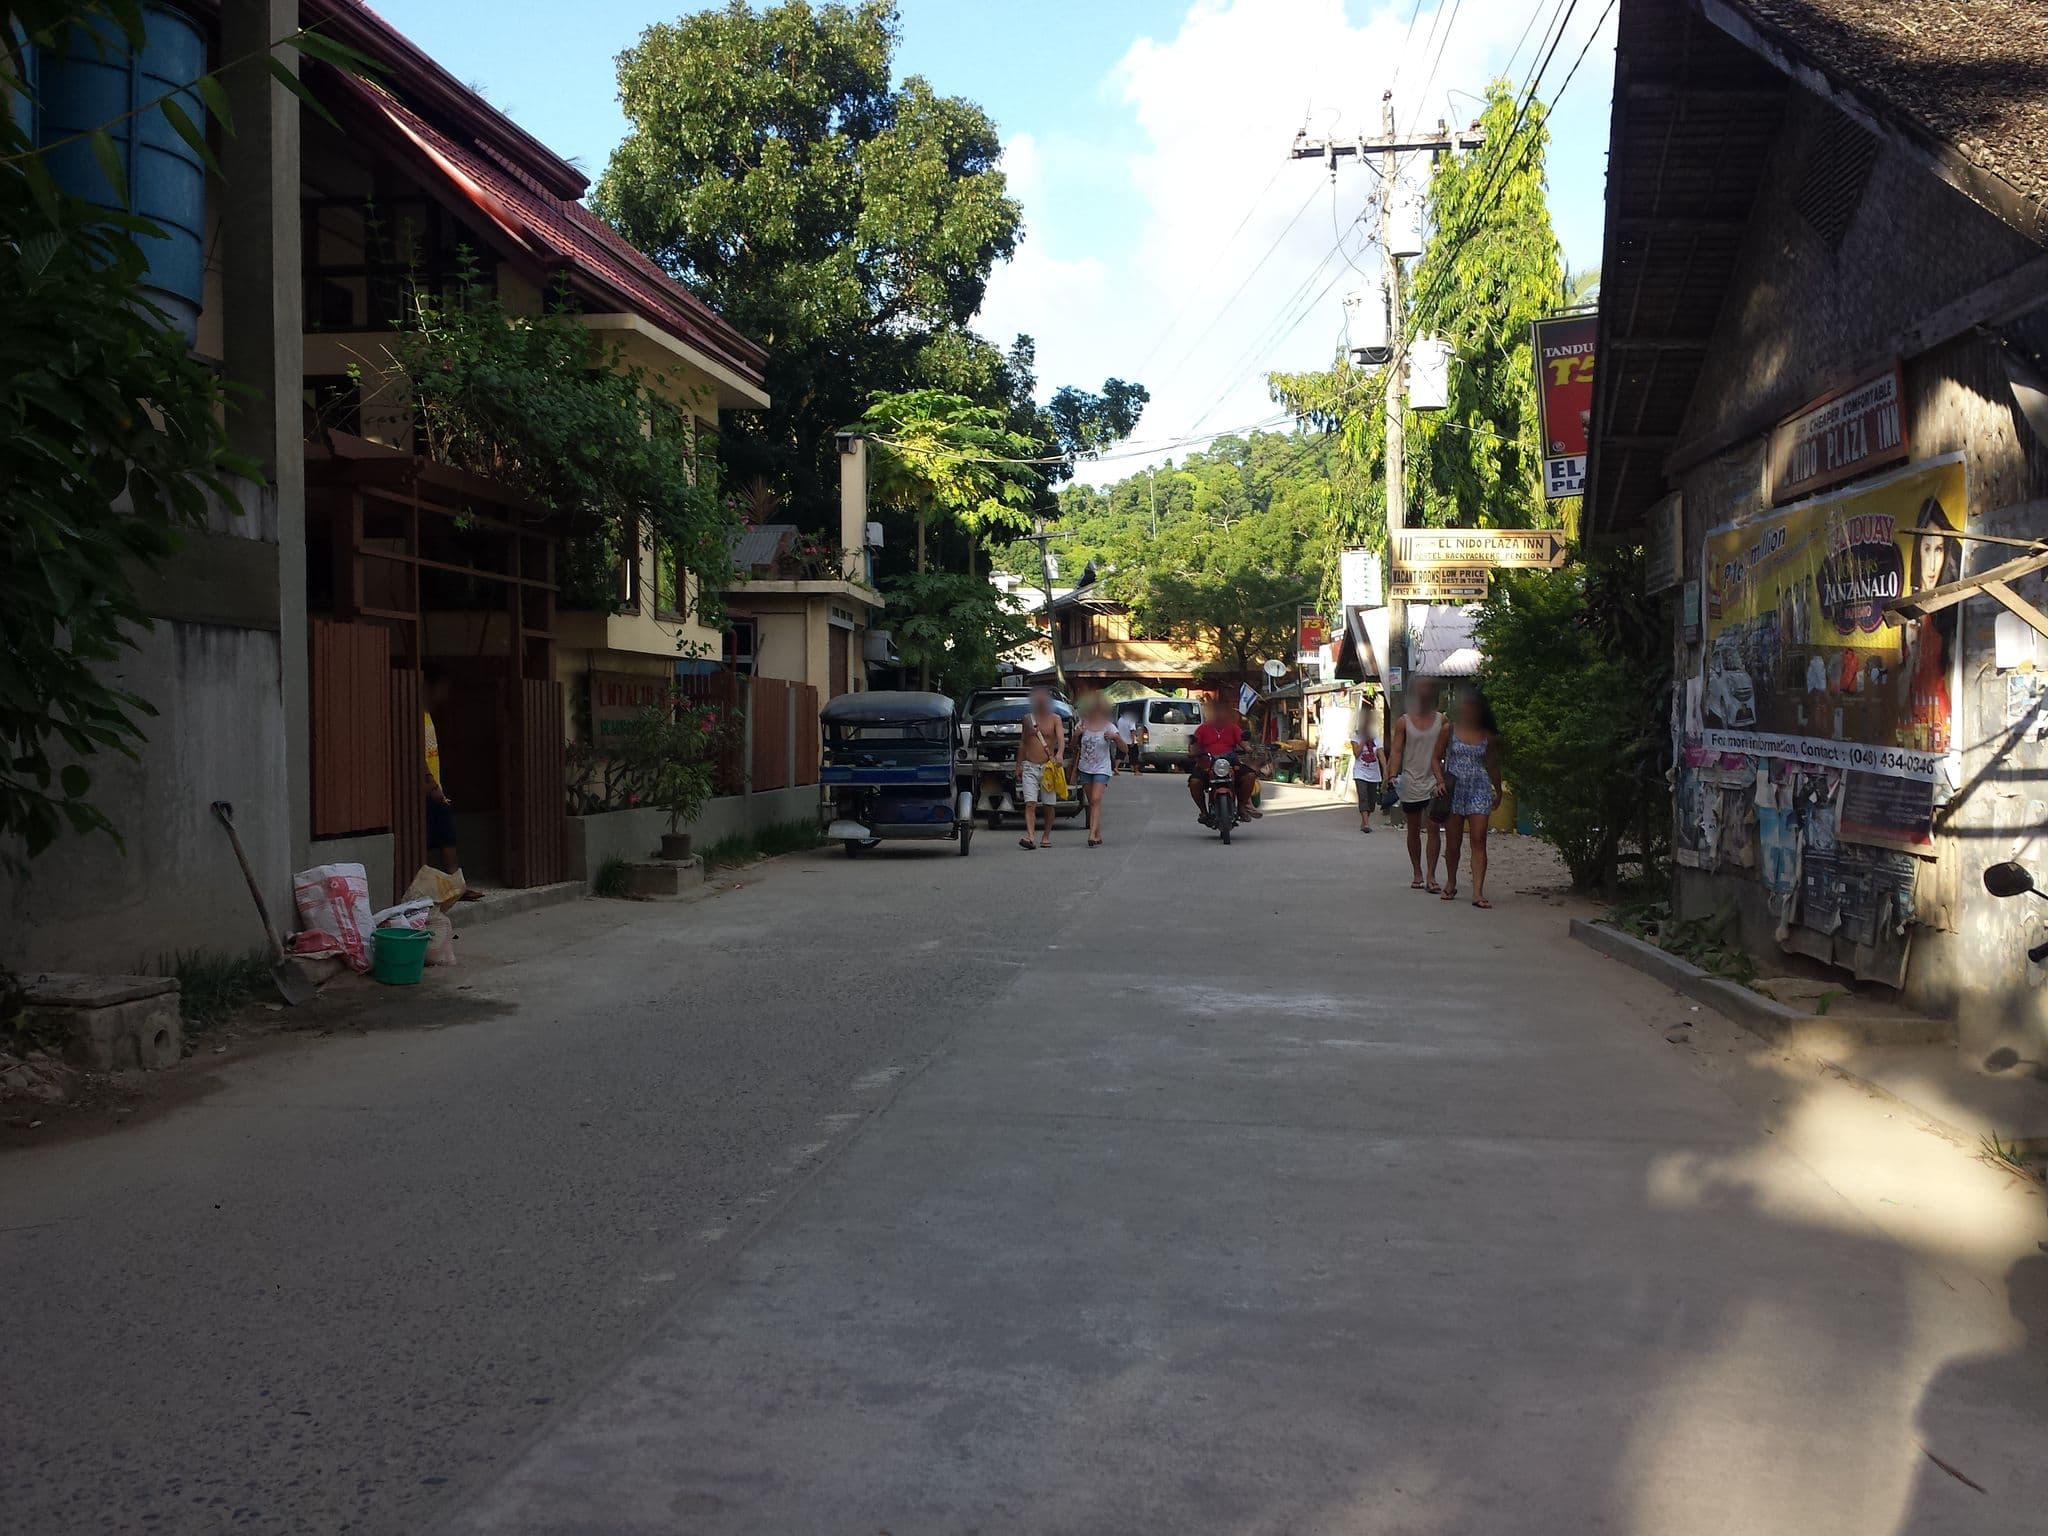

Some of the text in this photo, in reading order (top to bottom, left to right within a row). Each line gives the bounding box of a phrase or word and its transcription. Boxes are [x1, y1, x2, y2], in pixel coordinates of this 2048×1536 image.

[1843, 380, 1892, 417] COMFORTABLE
[1827, 417, 1869, 472] PLAZA
[1878, 401, 1901, 451] INN
[1550, 459, 1581, 479] EL
[1438, 538, 1452, 549] EL
[1456, 538, 1482, 549] NIDO
[1484, 538, 1519, 549] PLAZA
[1523, 538, 1544, 549] INN
[1392, 569, 1417, 584] VACANT
[1459, 570, 1484, 578] PRICE
[1801, 742, 1838, 761] Contact
